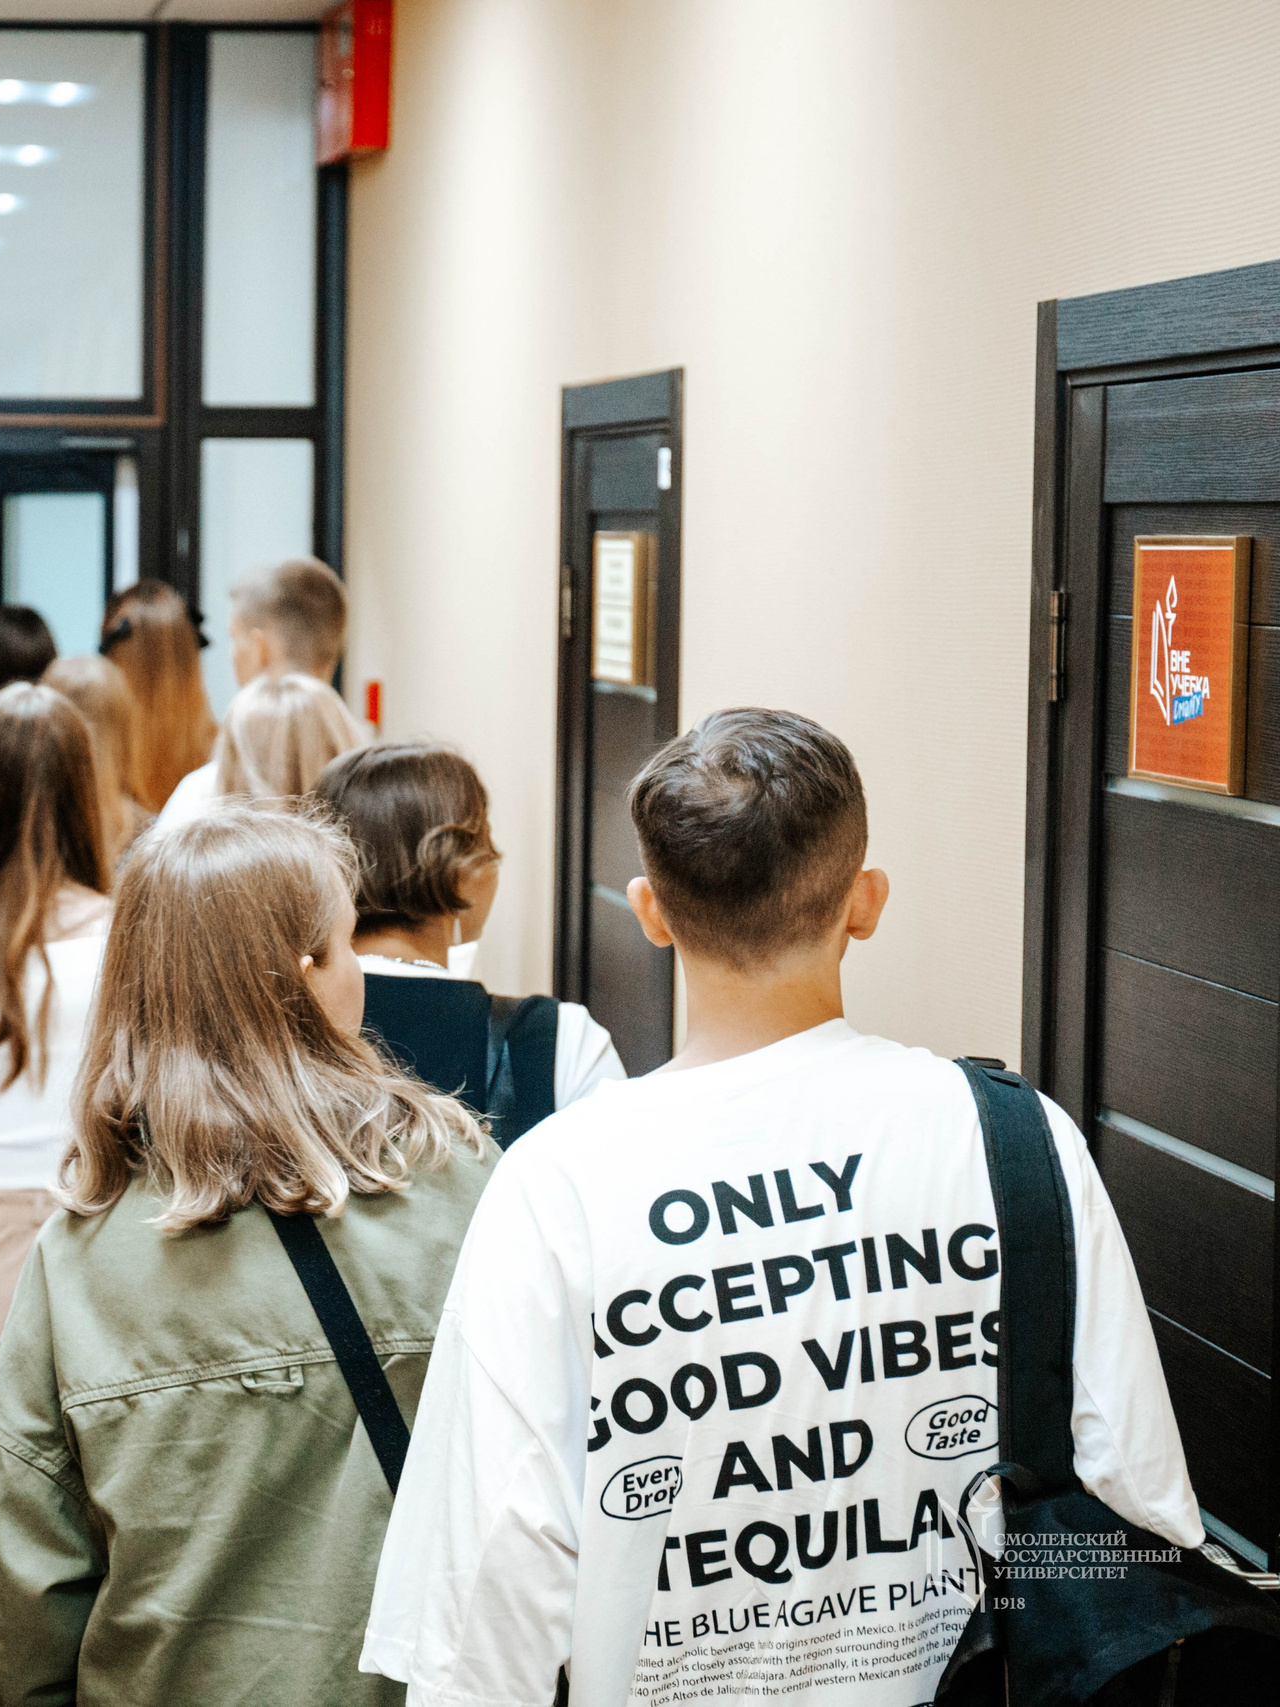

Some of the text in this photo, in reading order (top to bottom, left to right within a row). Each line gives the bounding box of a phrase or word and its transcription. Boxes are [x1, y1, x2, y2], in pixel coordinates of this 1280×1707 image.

[1170, 650, 1191, 673] ВНЕ
[1170, 673, 1210, 699] УЧЕБКА
[648, 1153, 863, 1246] ONLY
[926, 1427, 981, 1451] Taste
[928, 1402, 990, 1430] Good
[713, 1418, 874, 1499] AND
[657, 1488, 957, 1592] TEQUILA
[643, 1620, 684, 1648] HE
[692, 1602, 771, 1639] BLUE
[774, 1585, 878, 1628] AGAVE
[711, 1640, 755, 1657] beverage
[776, 1637, 808, 1651] origins
[810, 1629, 841, 1645] rooted
[844, 1627, 854, 1638] in
[856, 1624, 896, 1636] Mexico.
[899, 1622, 906, 1632] It
[908, 1619, 914, 1629] is
[651, 1678, 680, 1695] miles)
[682, 1671, 733, 1687] northwest
[790, 1658, 849, 1678] Additionally,
[851, 1658, 859, 1668] it
[861, 1656, 869, 1666] is
[872, 1648, 917, 1670] produced
[918, 1646, 925, 1655] in
[926, 1641, 940, 1652] the
[942, 1636, 961, 1648] Jali
[681, 1664, 689, 1672] is
[691, 1659, 725, 1672] closely
[763, 1654, 783, 1666] with
[785, 1653, 801, 1664] the
[803, 1646, 833, 1661] region
[835, 1636, 900, 1653] surrounding
[902, 1634, 916, 1645] the
[930, 1623, 939, 1635] of
[941, 1620, 968, 1633] Tequ
[650, 1695, 670, 1707] (Los
[672, 1690, 698, 1702] Altos
[700, 1687, 714, 1697] de
[762, 1686, 780, 1696] the
[781, 1679, 813, 1694] central
[814, 1675, 856, 1687] western
[858, 1669, 900, 1682] Mexican
[902, 1662, 923, 1675] state
[923, 1656, 932, 1667] of
